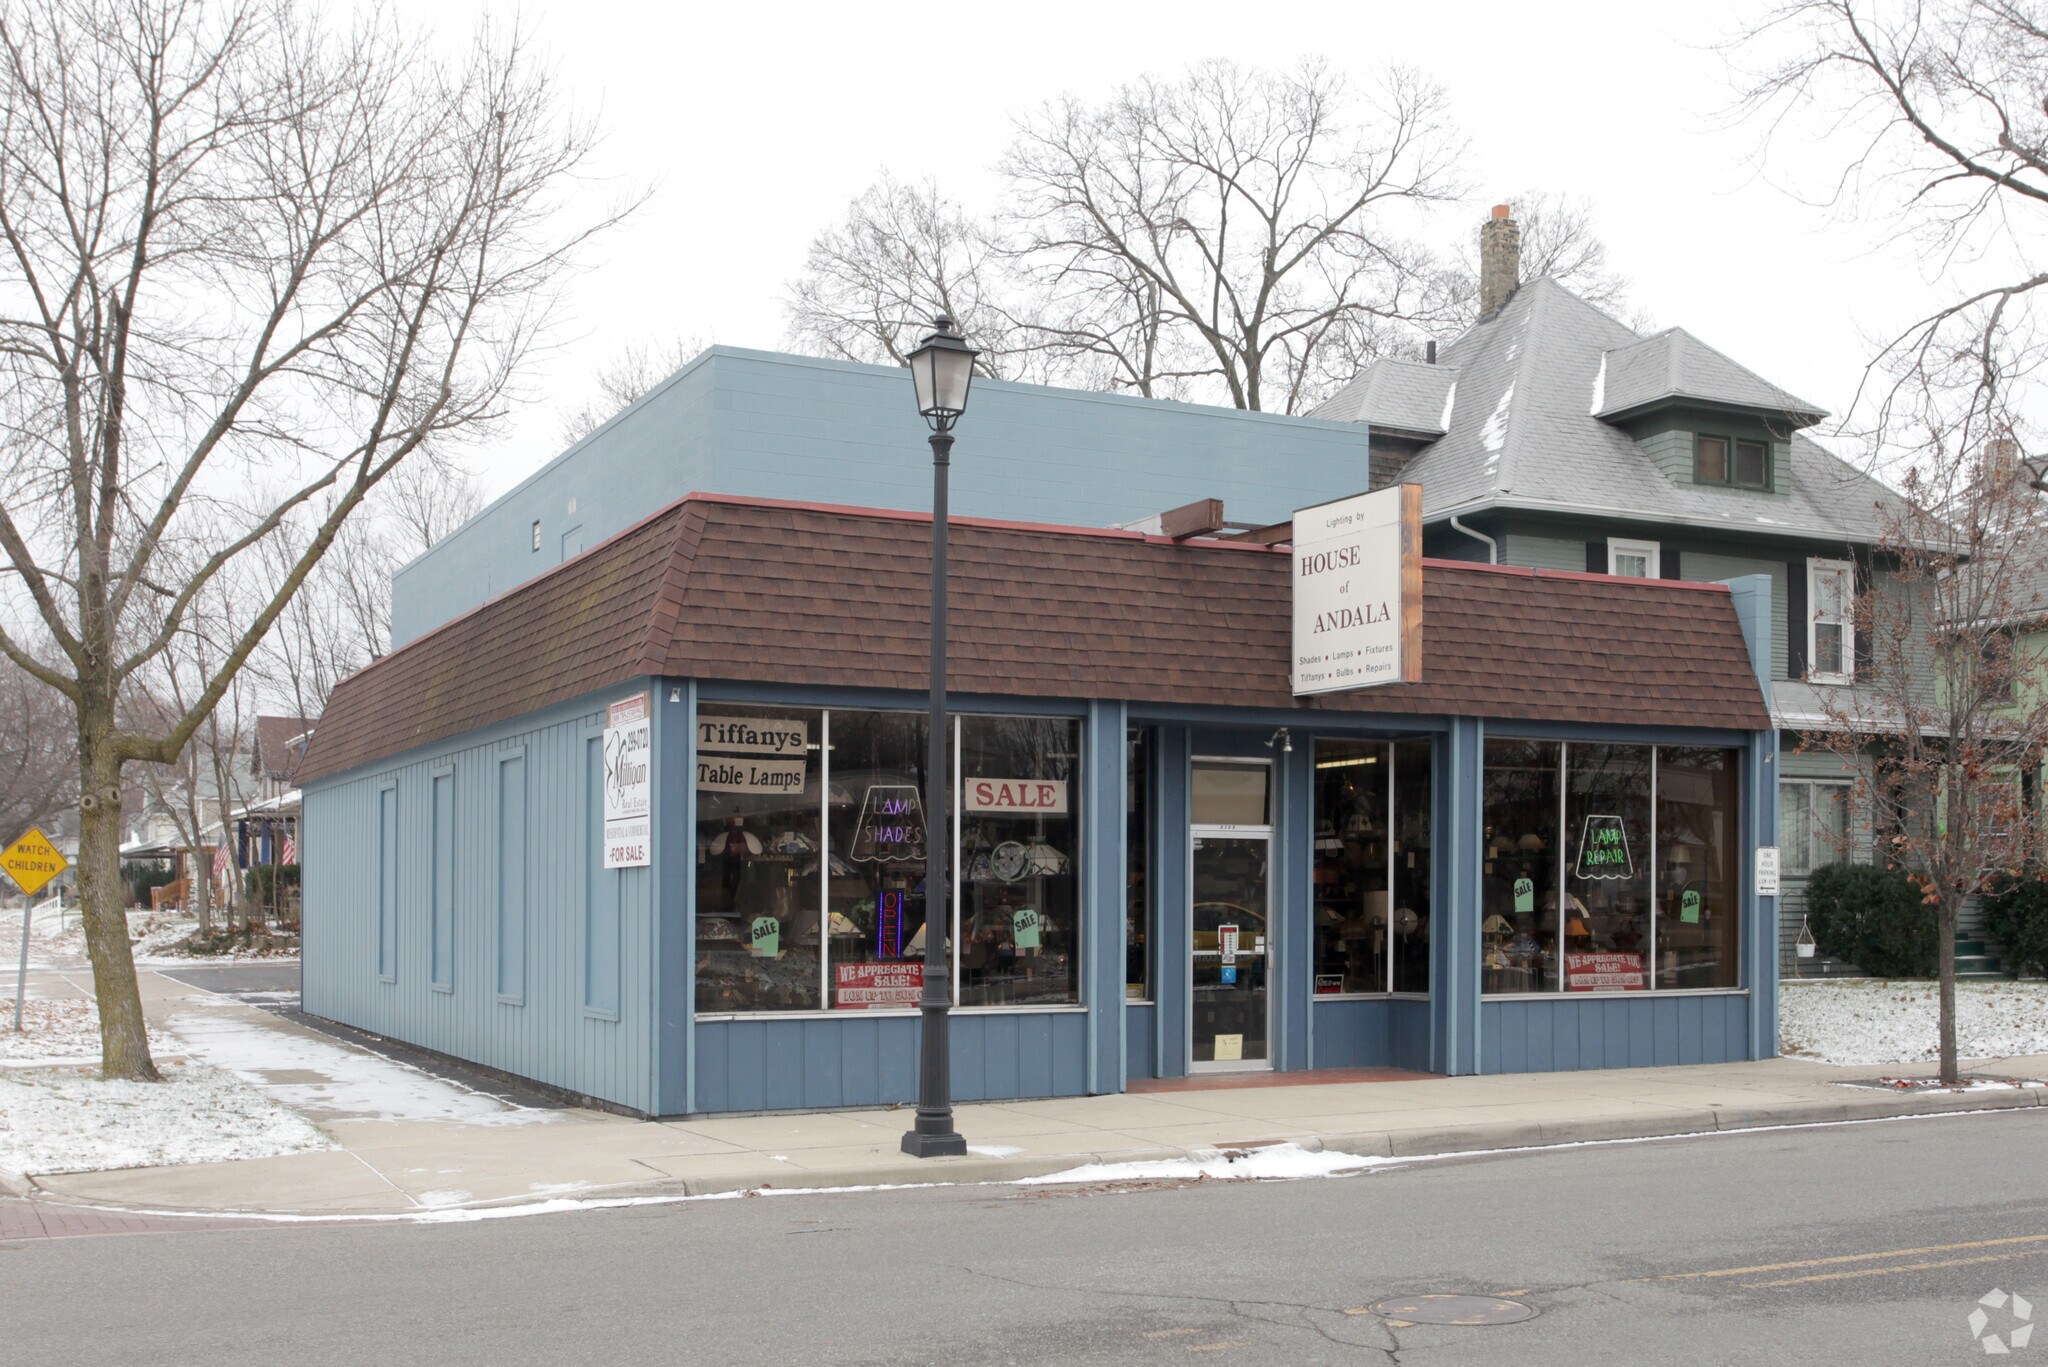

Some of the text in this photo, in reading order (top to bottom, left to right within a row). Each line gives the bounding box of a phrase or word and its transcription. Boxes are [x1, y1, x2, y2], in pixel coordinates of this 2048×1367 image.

[1326, 511, 1365, 529] Lighting by
[1300, 544, 1361, 577] HOUSE
[1339, 580, 1350, 594] of
[1313, 601, 1391, 634] ANDALA
[1299, 643, 1393, 666] Shades Lamps Fixtures
[1301, 662, 1392, 683] Tiffanys Bulbs Repairs
[628, 726, 649, 753] 299-0720
[699, 723, 802, 752] Tiffanys
[613, 754, 647, 790] Milligan
[697, 763, 801, 791] Table Lamps
[621, 797, 648, 809] Real Estate
[976, 782, 1056, 807] SALE
[873, 796, 916, 816] LAMP
[864, 826, 921, 844] SHADES
[1590, 828, 1622, 845] LAMP
[17, 844, 51, 856] WATCH
[1586, 849, 1624, 866] REPAIR
[8, 859, 56, 873] CHILDREN
[1515, 882, 1532, 898] SALE
[1682, 895, 1698, 909] SALE
[753, 922, 777, 940] SALE
[884, 892, 897, 958] OPEN
[1015, 914, 1037, 932] SALE
[1568, 954, 1641, 970] WE APPRECIATE YOU
[1594, 962, 1621, 973] SALE!
[840, 965, 856, 982] WE
[858, 964, 919, 978] APPRECIATE
[874, 975, 910, 987] SALE!
[843, 990, 864, 1002] 10%
[865, 990, 878, 1001] UP
[879, 989, 892, 1001] TO
